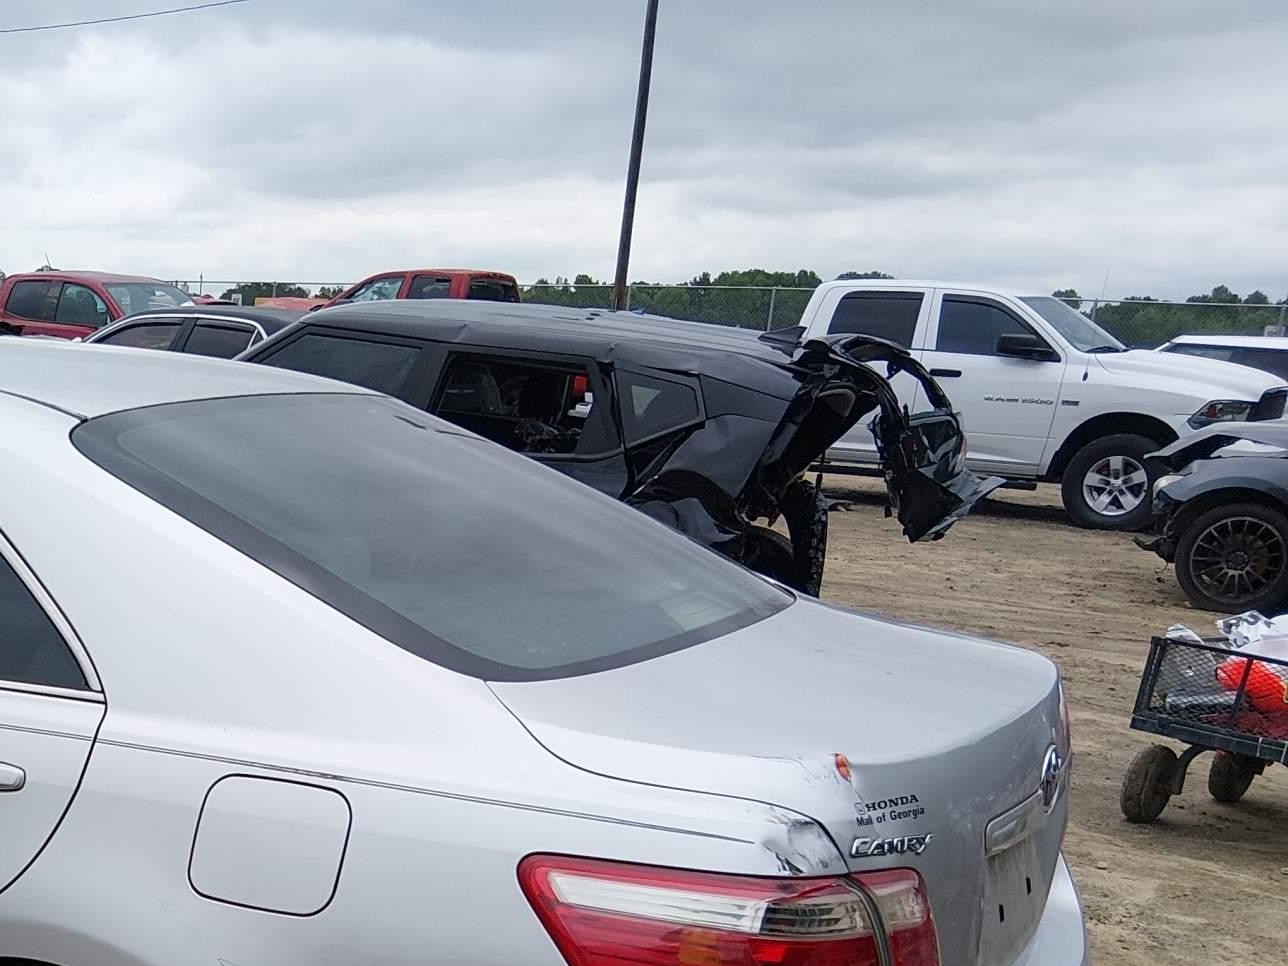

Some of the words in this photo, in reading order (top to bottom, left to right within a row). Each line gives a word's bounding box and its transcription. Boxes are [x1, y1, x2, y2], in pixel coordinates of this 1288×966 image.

[865, 794, 919, 812] HONDA
[856, 815, 873, 827] Mall
[876, 812, 886, 824] of
[890, 804, 925, 820] Georgia
[850, 833, 934, 858] CAMRY
